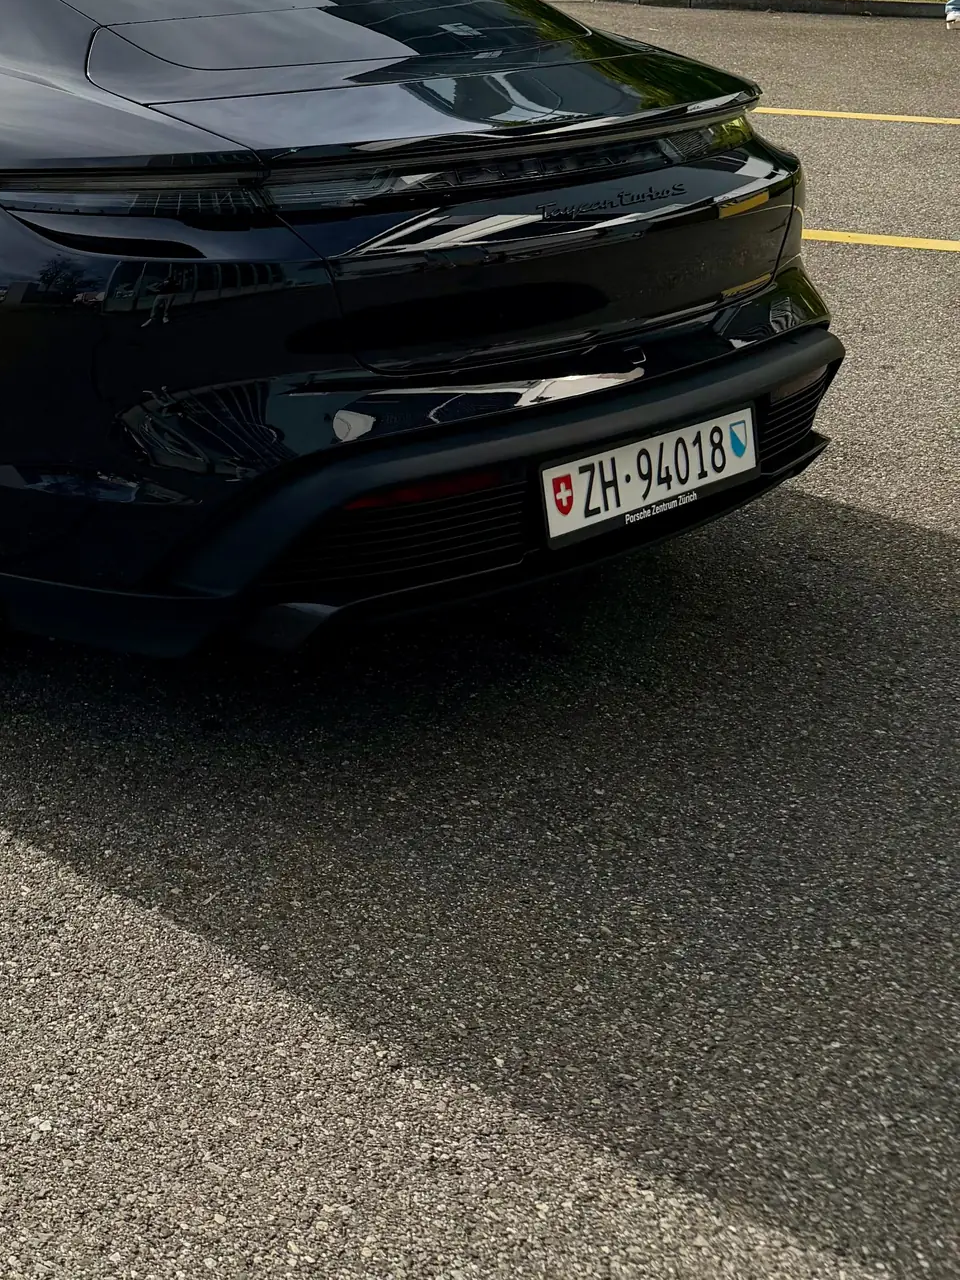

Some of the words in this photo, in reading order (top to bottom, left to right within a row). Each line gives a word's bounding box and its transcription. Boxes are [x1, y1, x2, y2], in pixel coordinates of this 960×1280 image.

[625, 508, 652, 524] Porsche
[651, 499, 678, 515] Zentrum
[678, 491, 698, 506] Zürich
